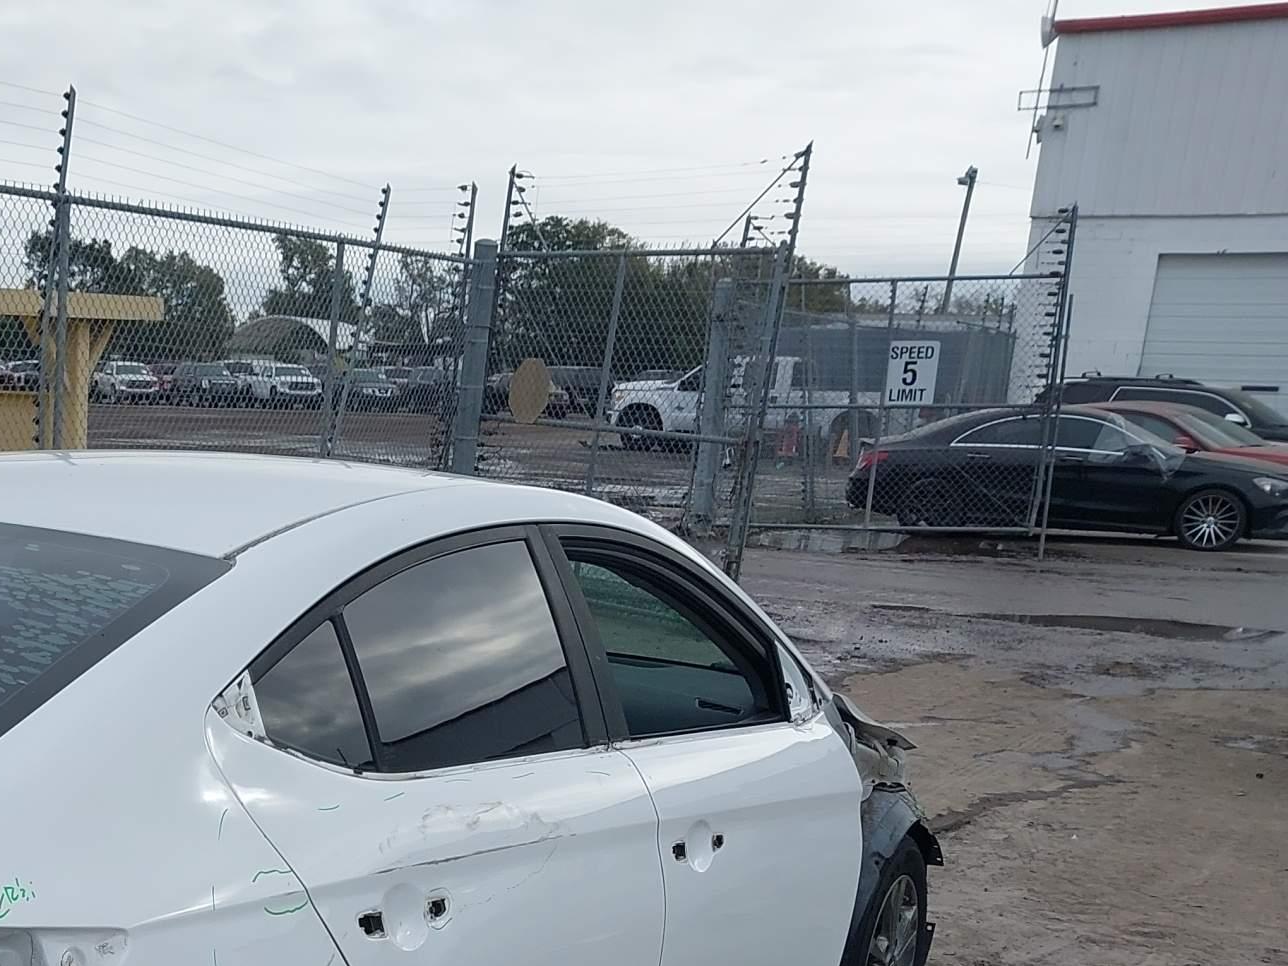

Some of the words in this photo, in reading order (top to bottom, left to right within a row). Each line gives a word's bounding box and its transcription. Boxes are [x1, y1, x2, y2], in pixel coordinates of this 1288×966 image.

[890, 345, 934, 360] SPEED
[902, 361, 918, 386] 5
[888, 388, 926, 402] LIMIT
